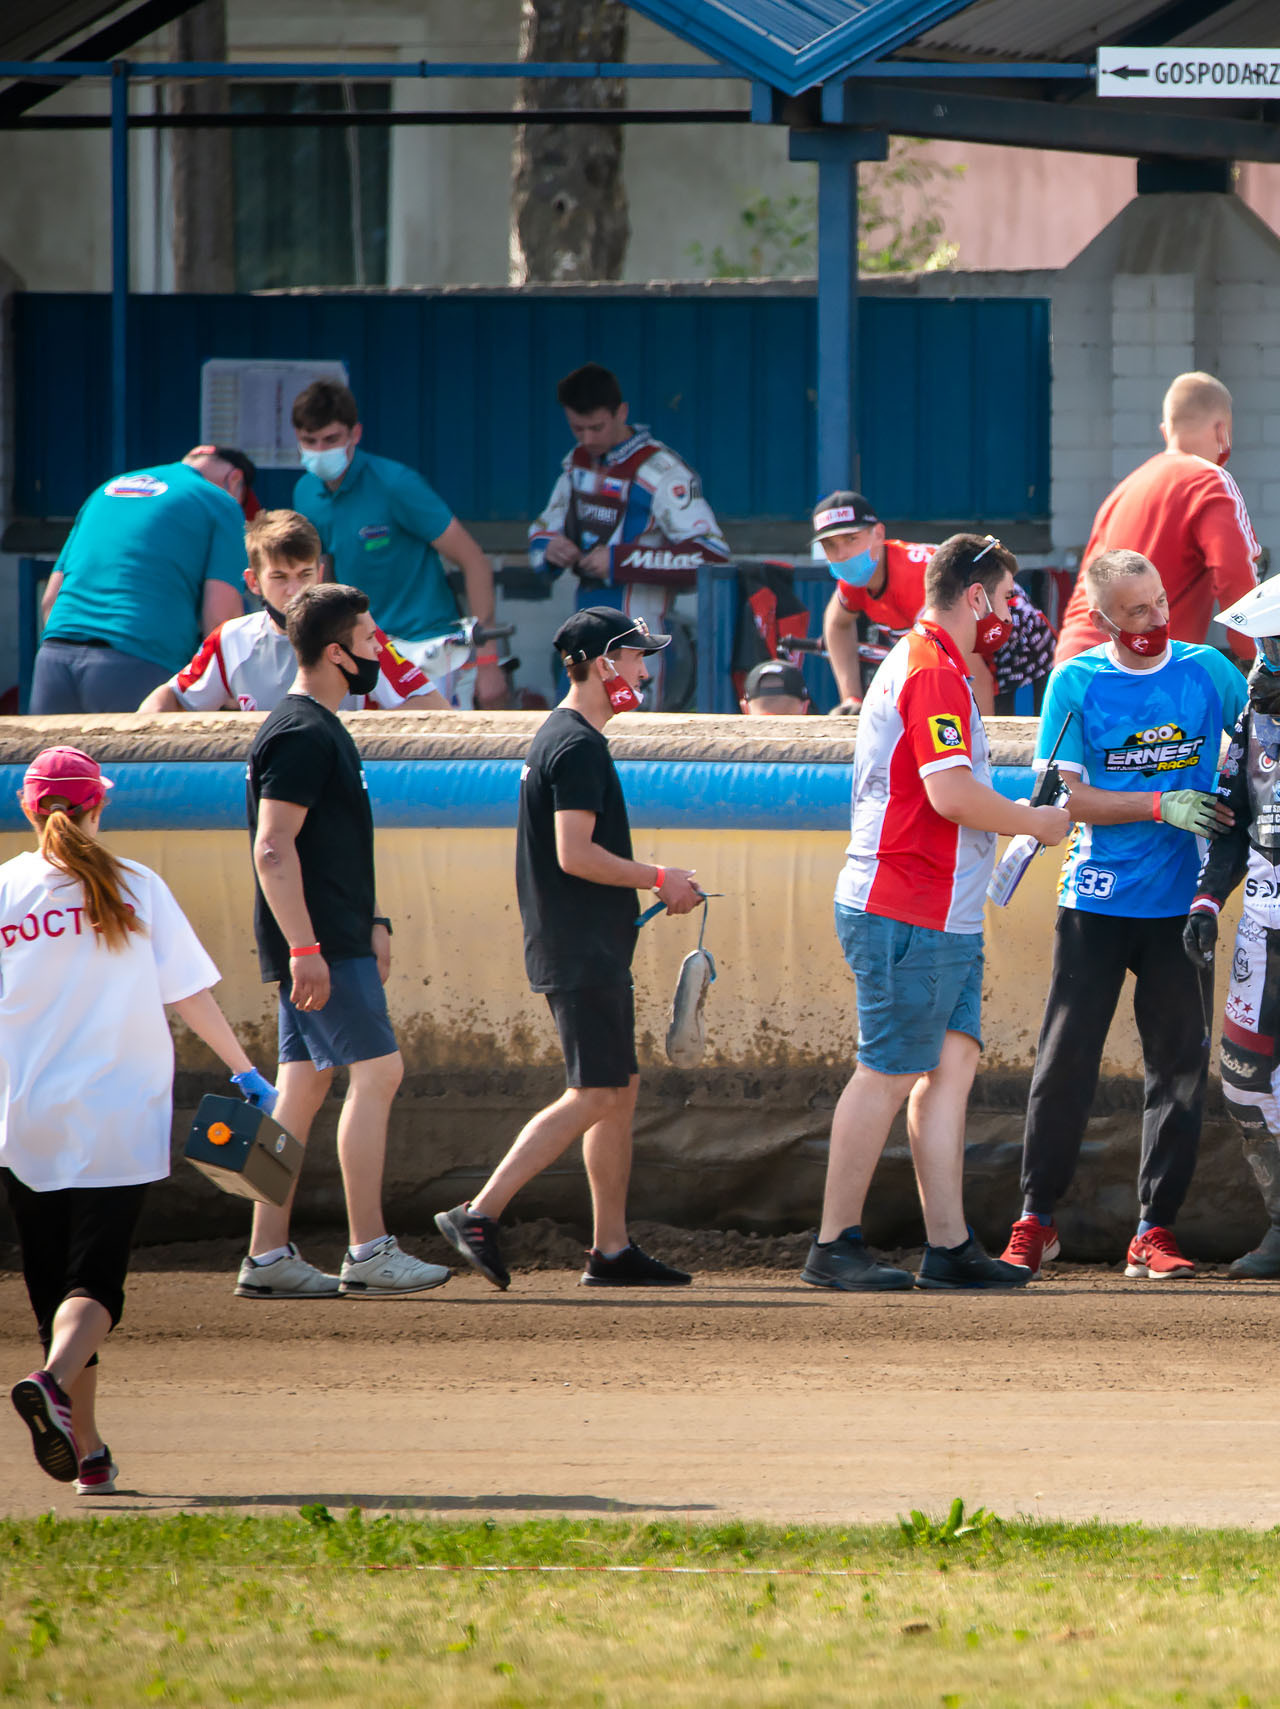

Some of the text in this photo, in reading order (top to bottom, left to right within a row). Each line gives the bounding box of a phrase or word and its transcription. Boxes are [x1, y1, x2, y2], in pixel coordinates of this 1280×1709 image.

[620, 550, 705, 570] Mitas
[1107, 740, 1204, 766] ERNEST
[1078, 867, 1116, 898] 33
[0, 903, 136, 949] DOCT
